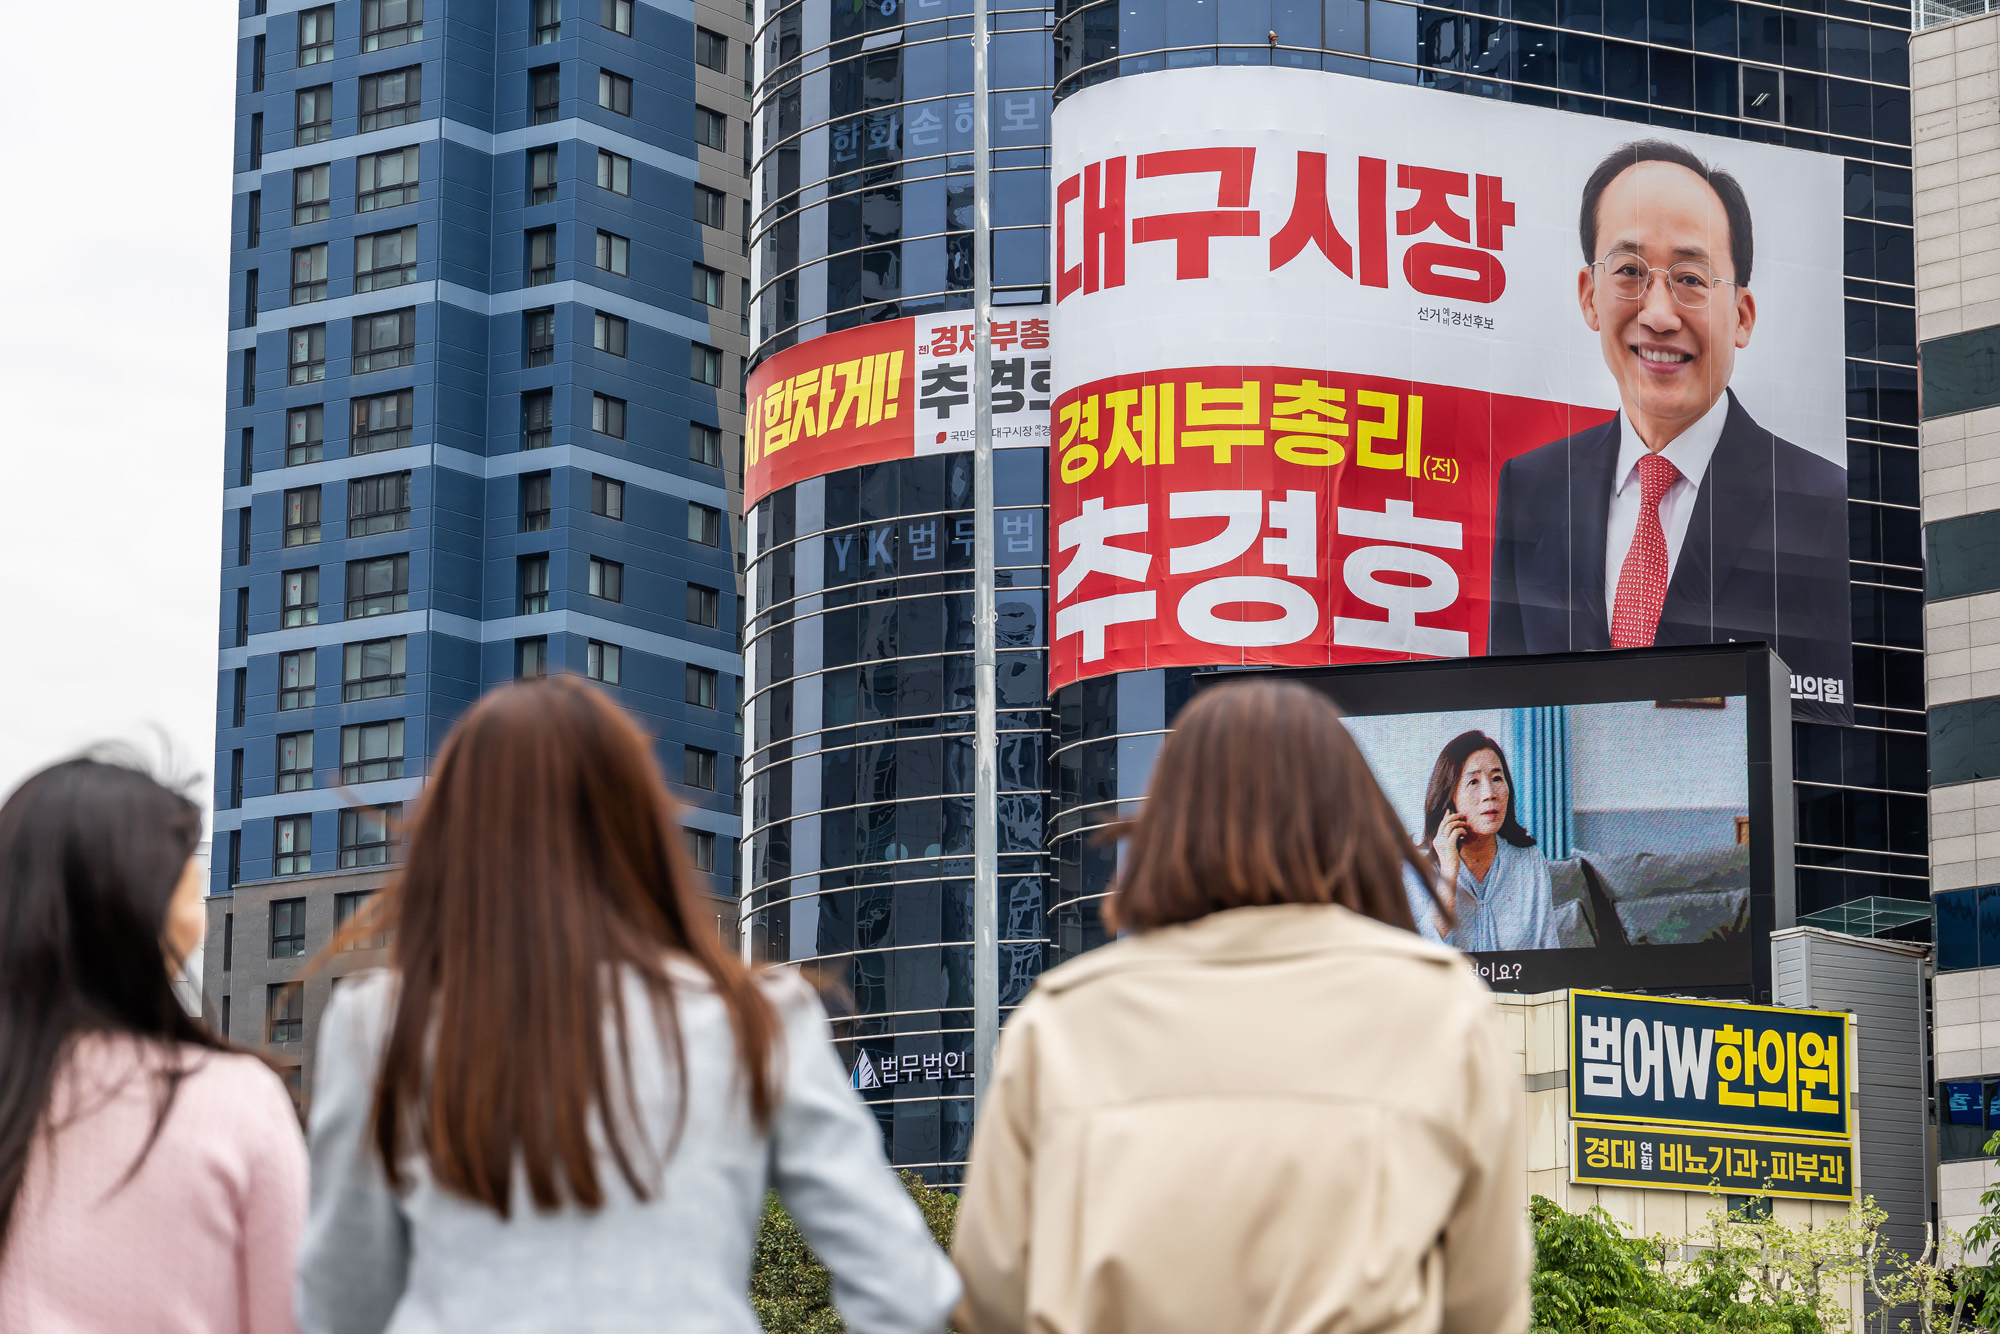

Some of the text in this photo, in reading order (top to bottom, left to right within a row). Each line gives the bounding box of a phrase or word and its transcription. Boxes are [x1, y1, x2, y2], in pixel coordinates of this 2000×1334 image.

[1056, 147, 1516, 307] 대구시장
[1418, 306, 1440, 323] 선거
[1451, 311, 1495, 330] 경선후보
[764, 350, 904, 457] 힘차게!
[992, 425, 1032, 438] 대구시장
[1056, 489, 1470, 663] 추경호
[881, 1051, 965, 1083] 법무법인
[1585, 1137, 1635, 1169] 경대
